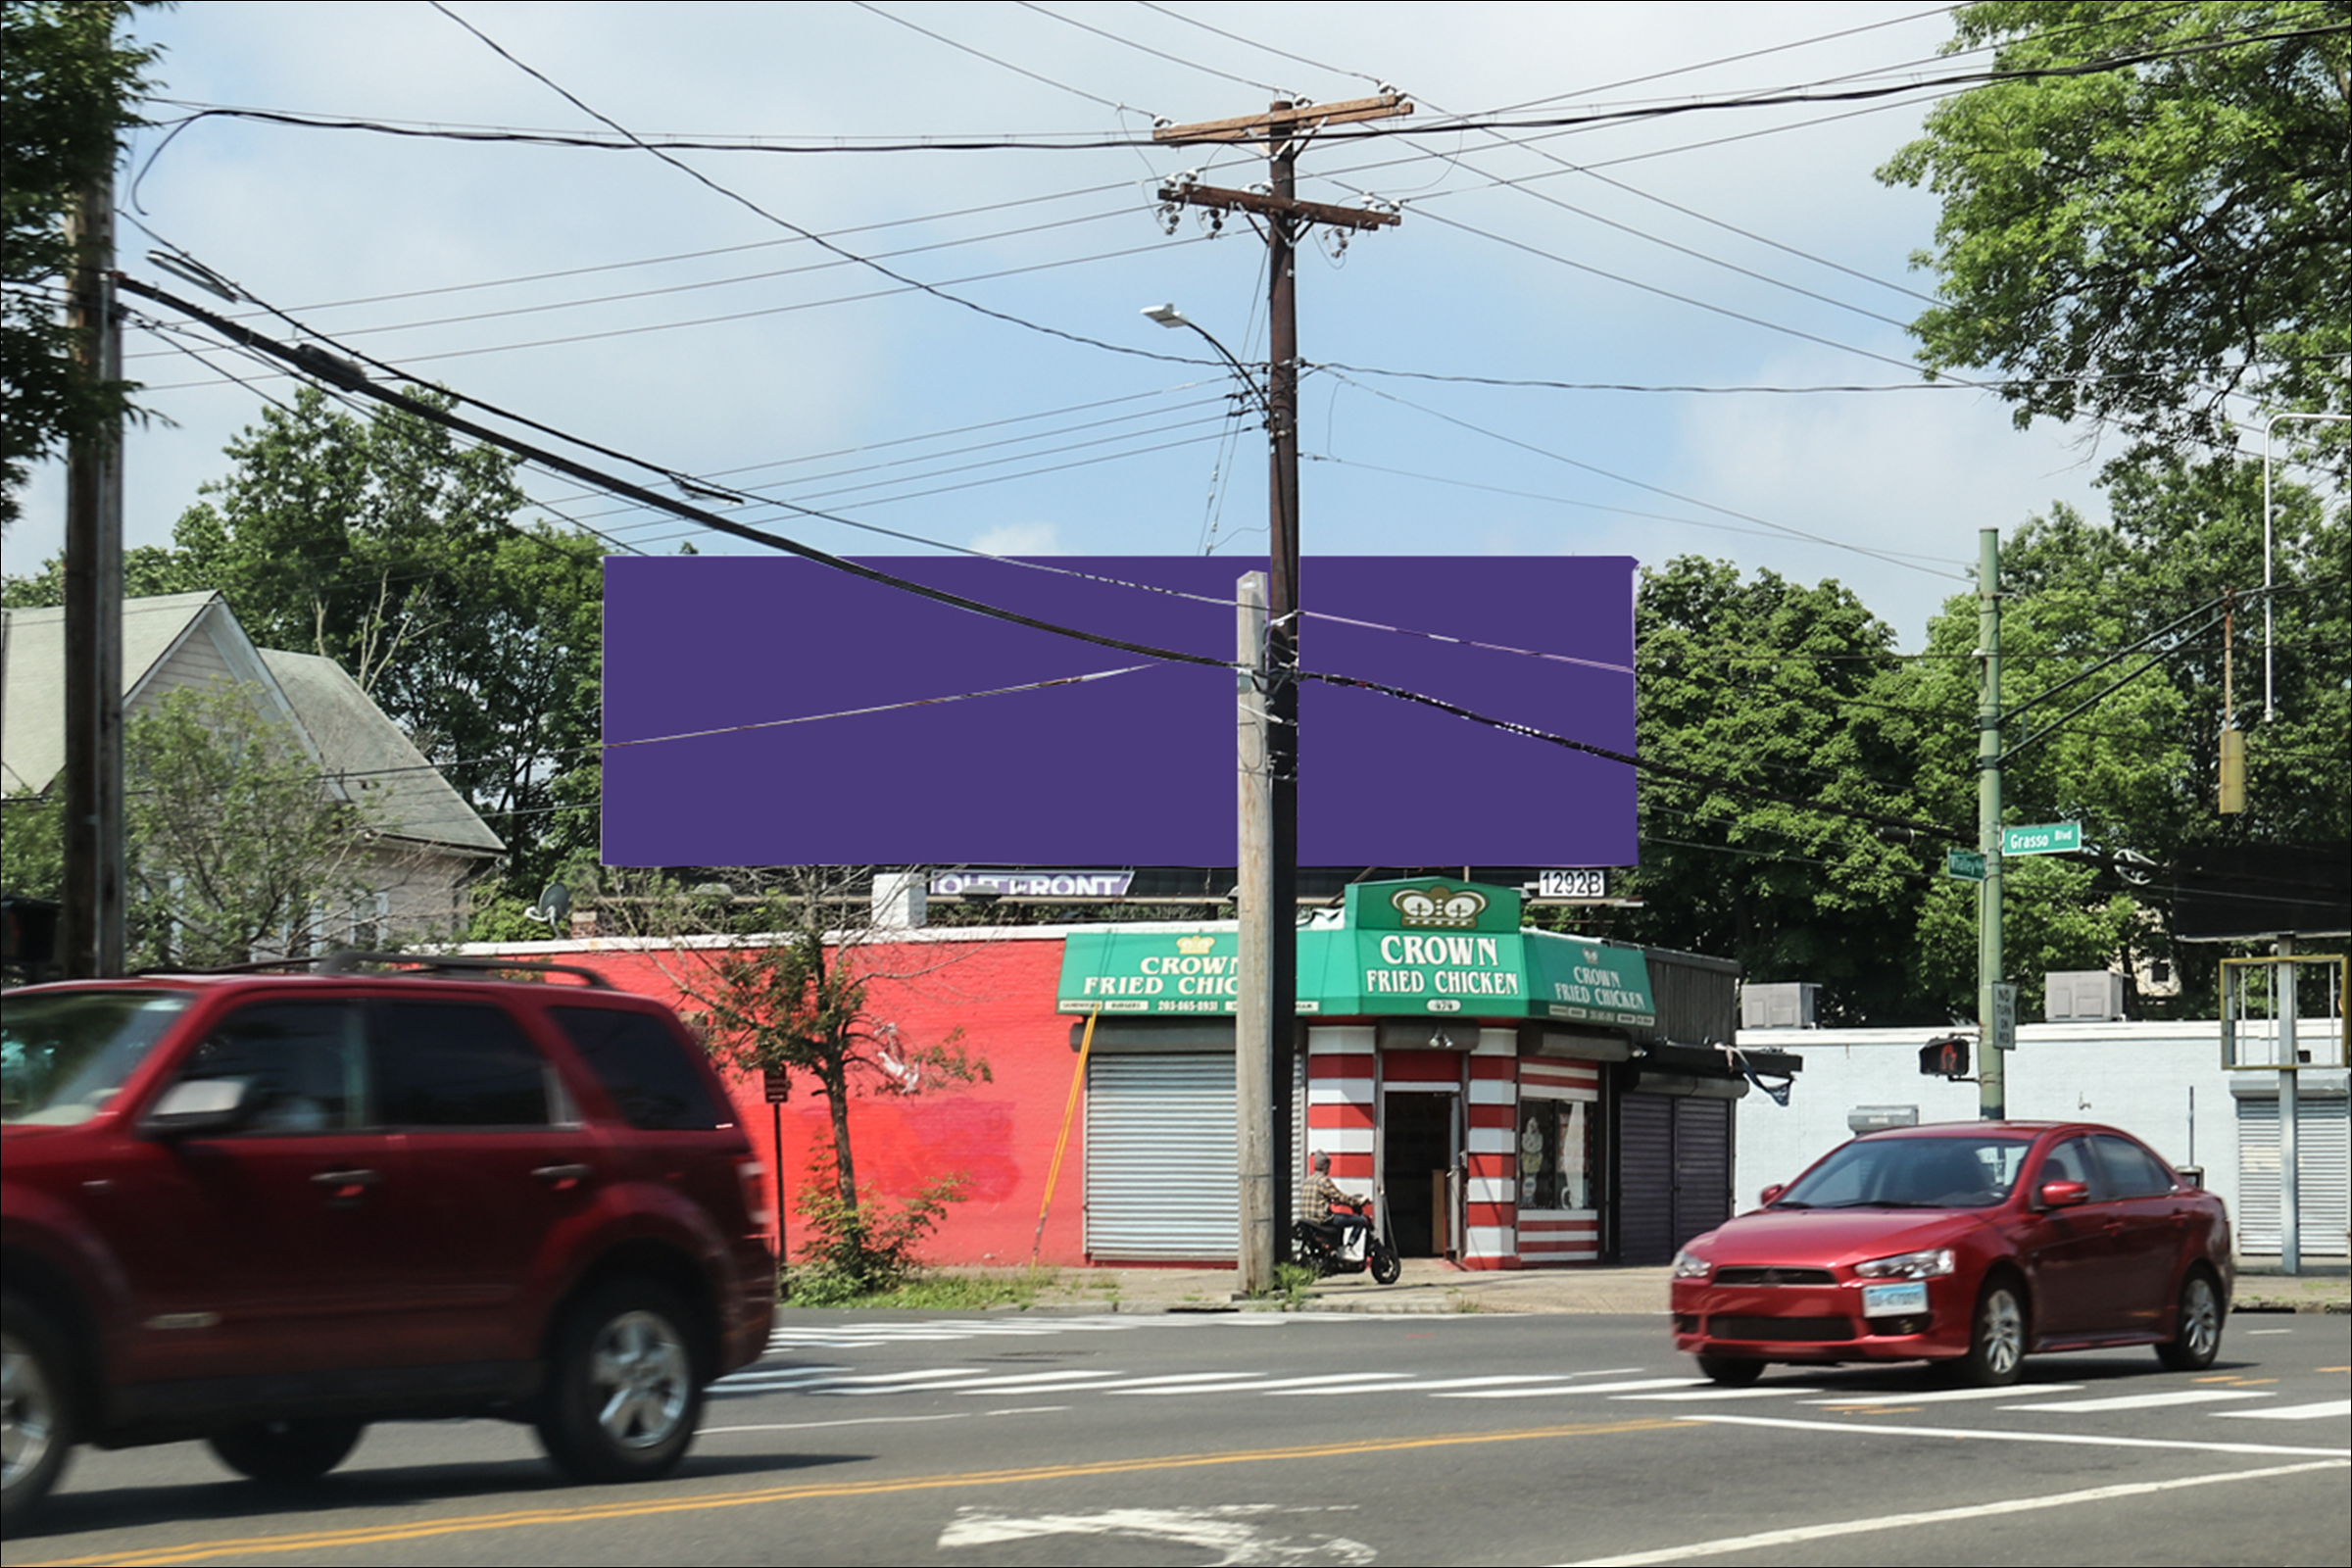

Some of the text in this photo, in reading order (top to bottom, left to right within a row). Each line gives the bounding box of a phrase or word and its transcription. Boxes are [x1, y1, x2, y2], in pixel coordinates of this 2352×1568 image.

[2010, 829, 2073, 850] Grasso Blvd
[1543, 871, 1601, 894] 1292B
[1380, 934, 1499, 966] CROWN
[1083, 976, 1238, 996] FRIED CHIC
[1366, 969, 1519, 995] FRIED CHICKEN
[1573, 965, 1622, 989] CROWN
[1554, 982, 1645, 1010] FRIED CHICKEN
[1997, 988, 2010, 1003] NO
